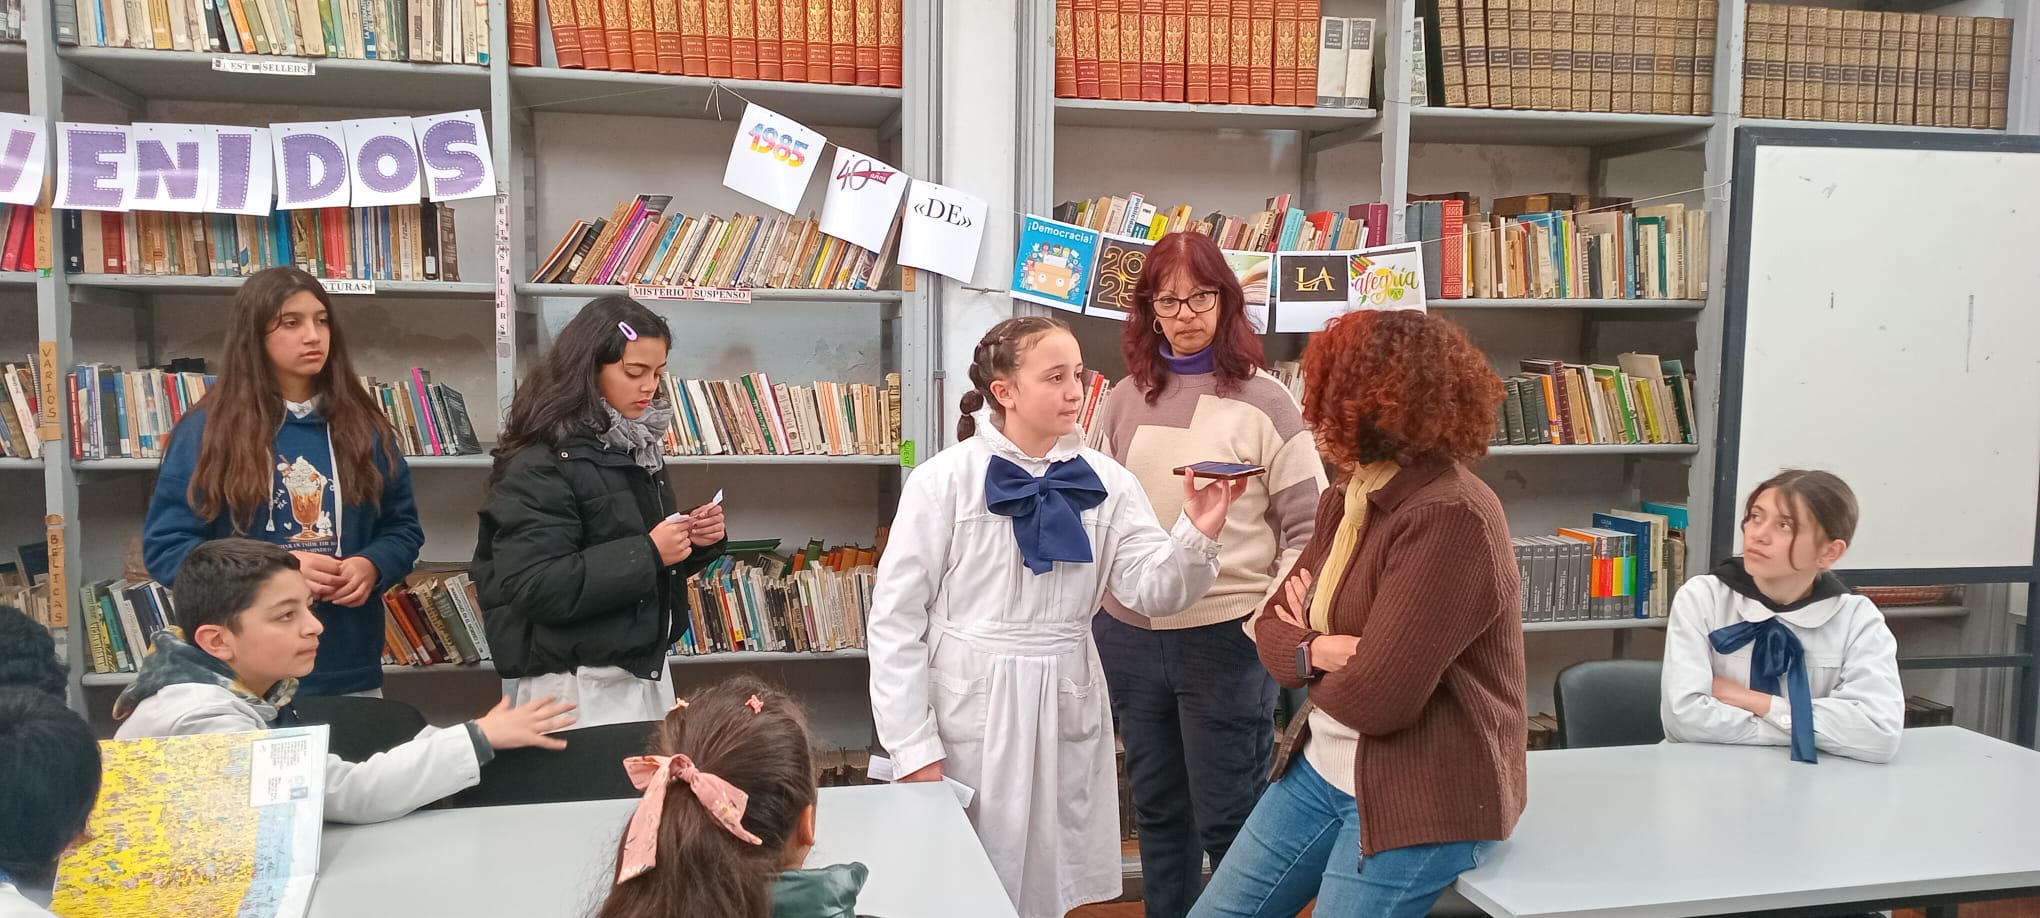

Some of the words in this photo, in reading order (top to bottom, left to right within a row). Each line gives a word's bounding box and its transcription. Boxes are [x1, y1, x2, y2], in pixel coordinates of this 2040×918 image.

[262, 63, 307, 73] SELLERS
[748, 123, 809, 167] 1985
[837, 159, 872, 190] 40
[1027, 221, 1093, 244] ¡Democracia!
[1101, 245, 1147, 284] 20
[1294, 265, 1336, 291] LA
[499, 253, 507, 331] SELLERS
[633, 287, 684, 297] MISTERIO
[694, 289, 746, 299] SUSPENSO
[42, 347, 57, 418] VARIOS
